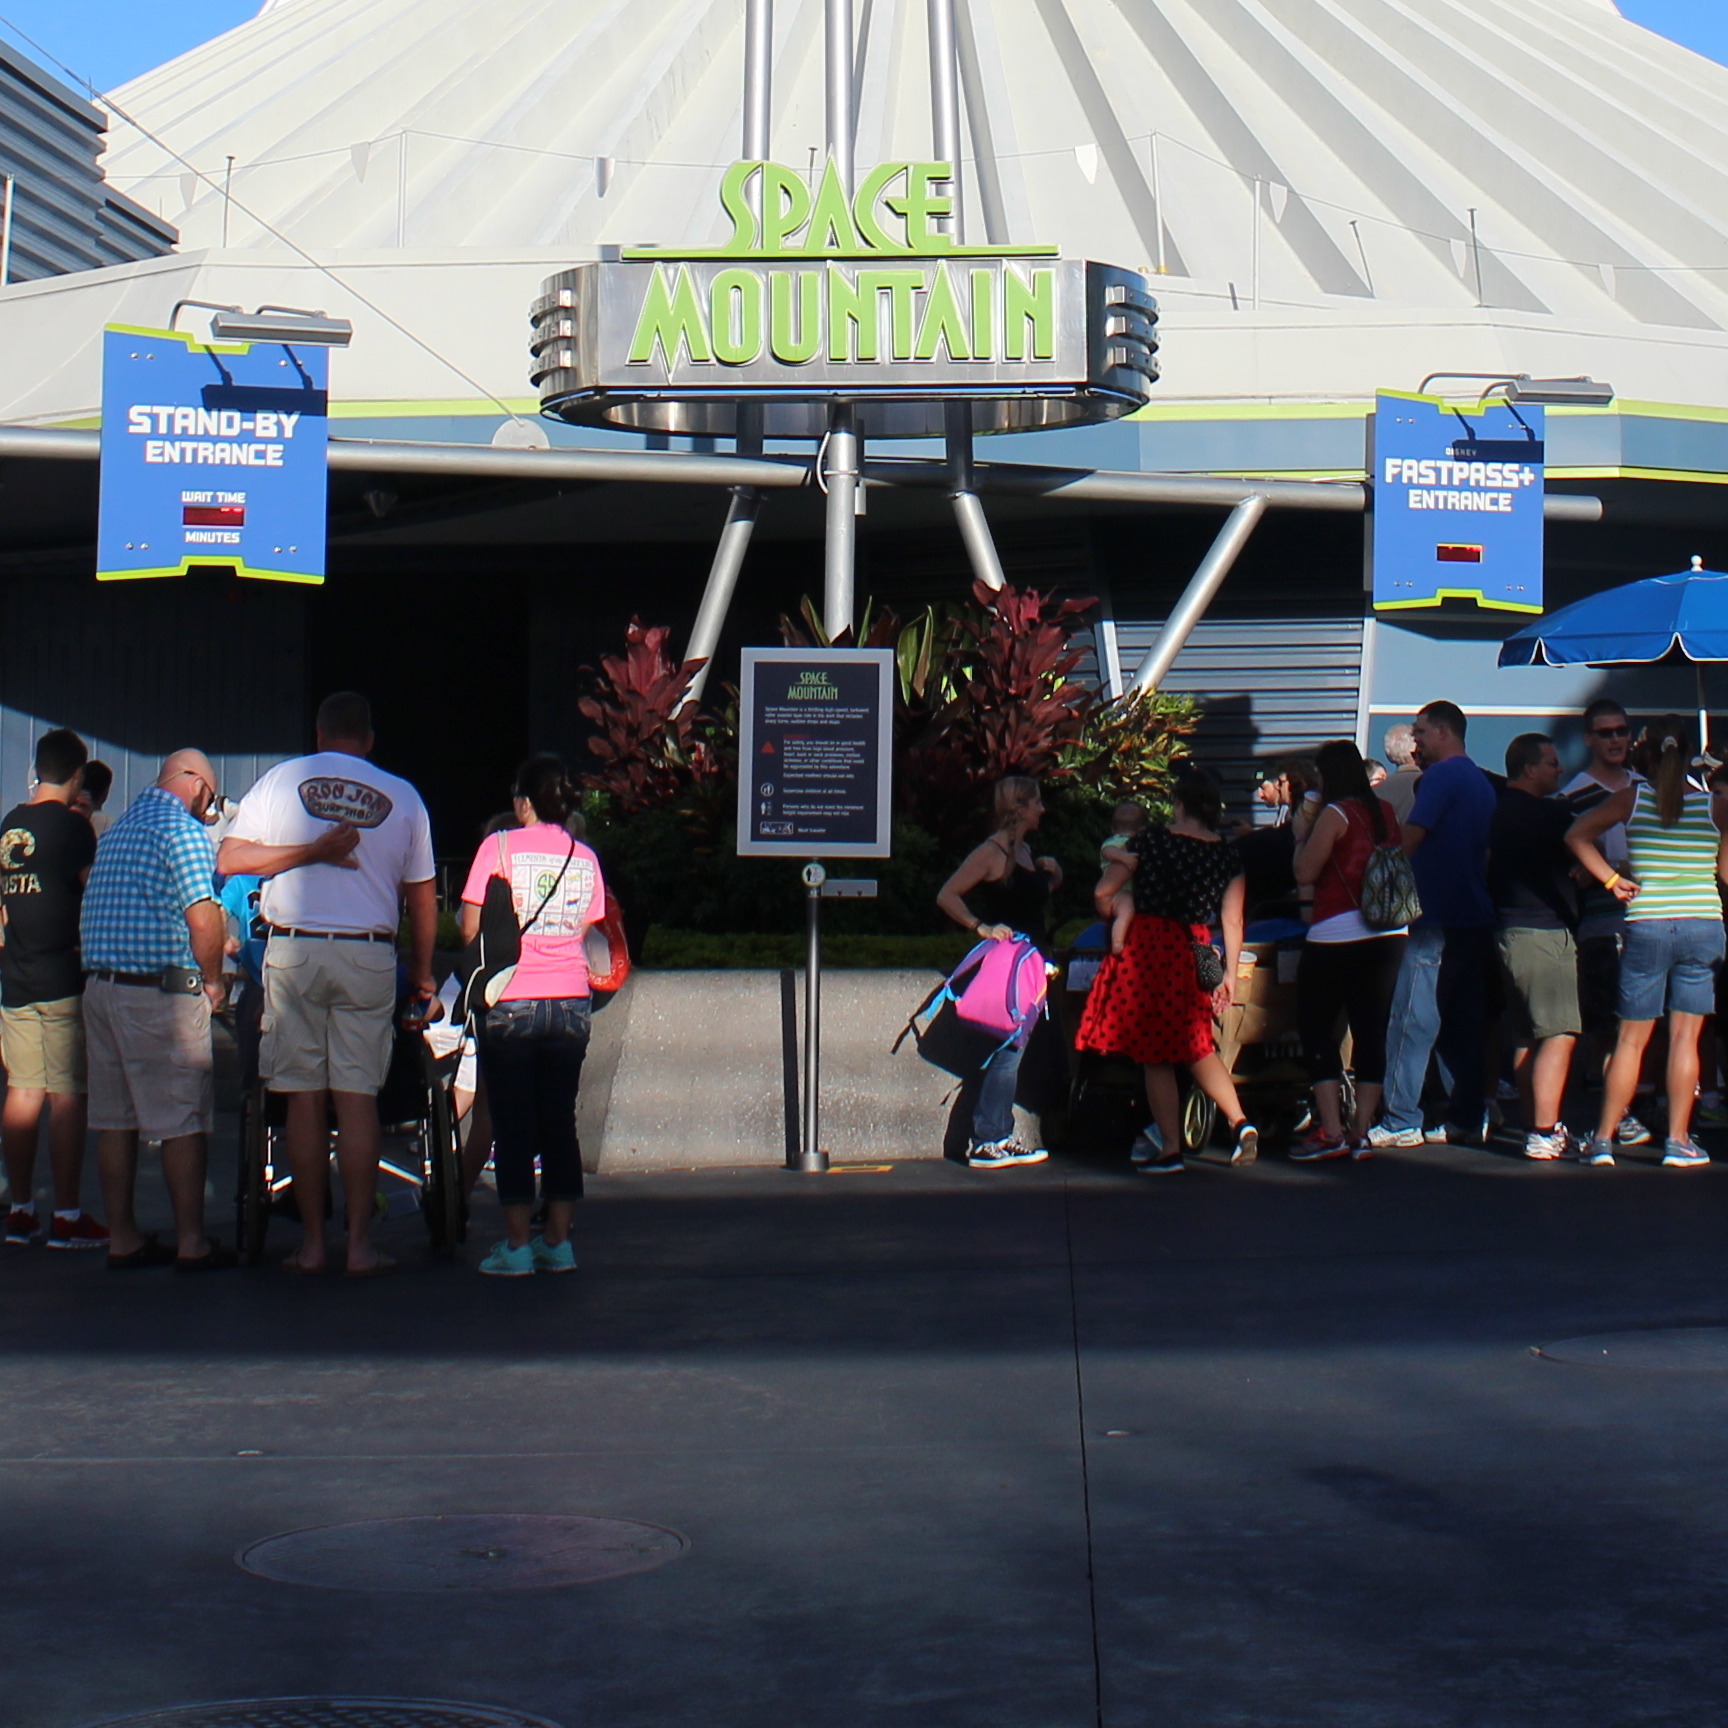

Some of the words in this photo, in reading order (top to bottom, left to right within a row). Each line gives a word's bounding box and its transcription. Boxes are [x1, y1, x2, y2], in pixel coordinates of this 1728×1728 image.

[720, 155, 952, 252] SPACE
[627, 261, 1056, 383] MOUNTAIN
[127, 404, 301, 439] STAND-BY
[144, 440, 285, 467] ENTRANCE
[1384, 457, 1535, 489] FASTPASS+
[181, 490, 214, 503] WAIT
[216, 491, 247, 504] TIME
[1408, 489, 1513, 512] ENTRANCE
[184, 531, 241, 544] MINUTES
[799, 671, 828, 685] SPACE
[787, 685, 839, 700] MOUNTAIN
[307, 782, 345, 803] RON
